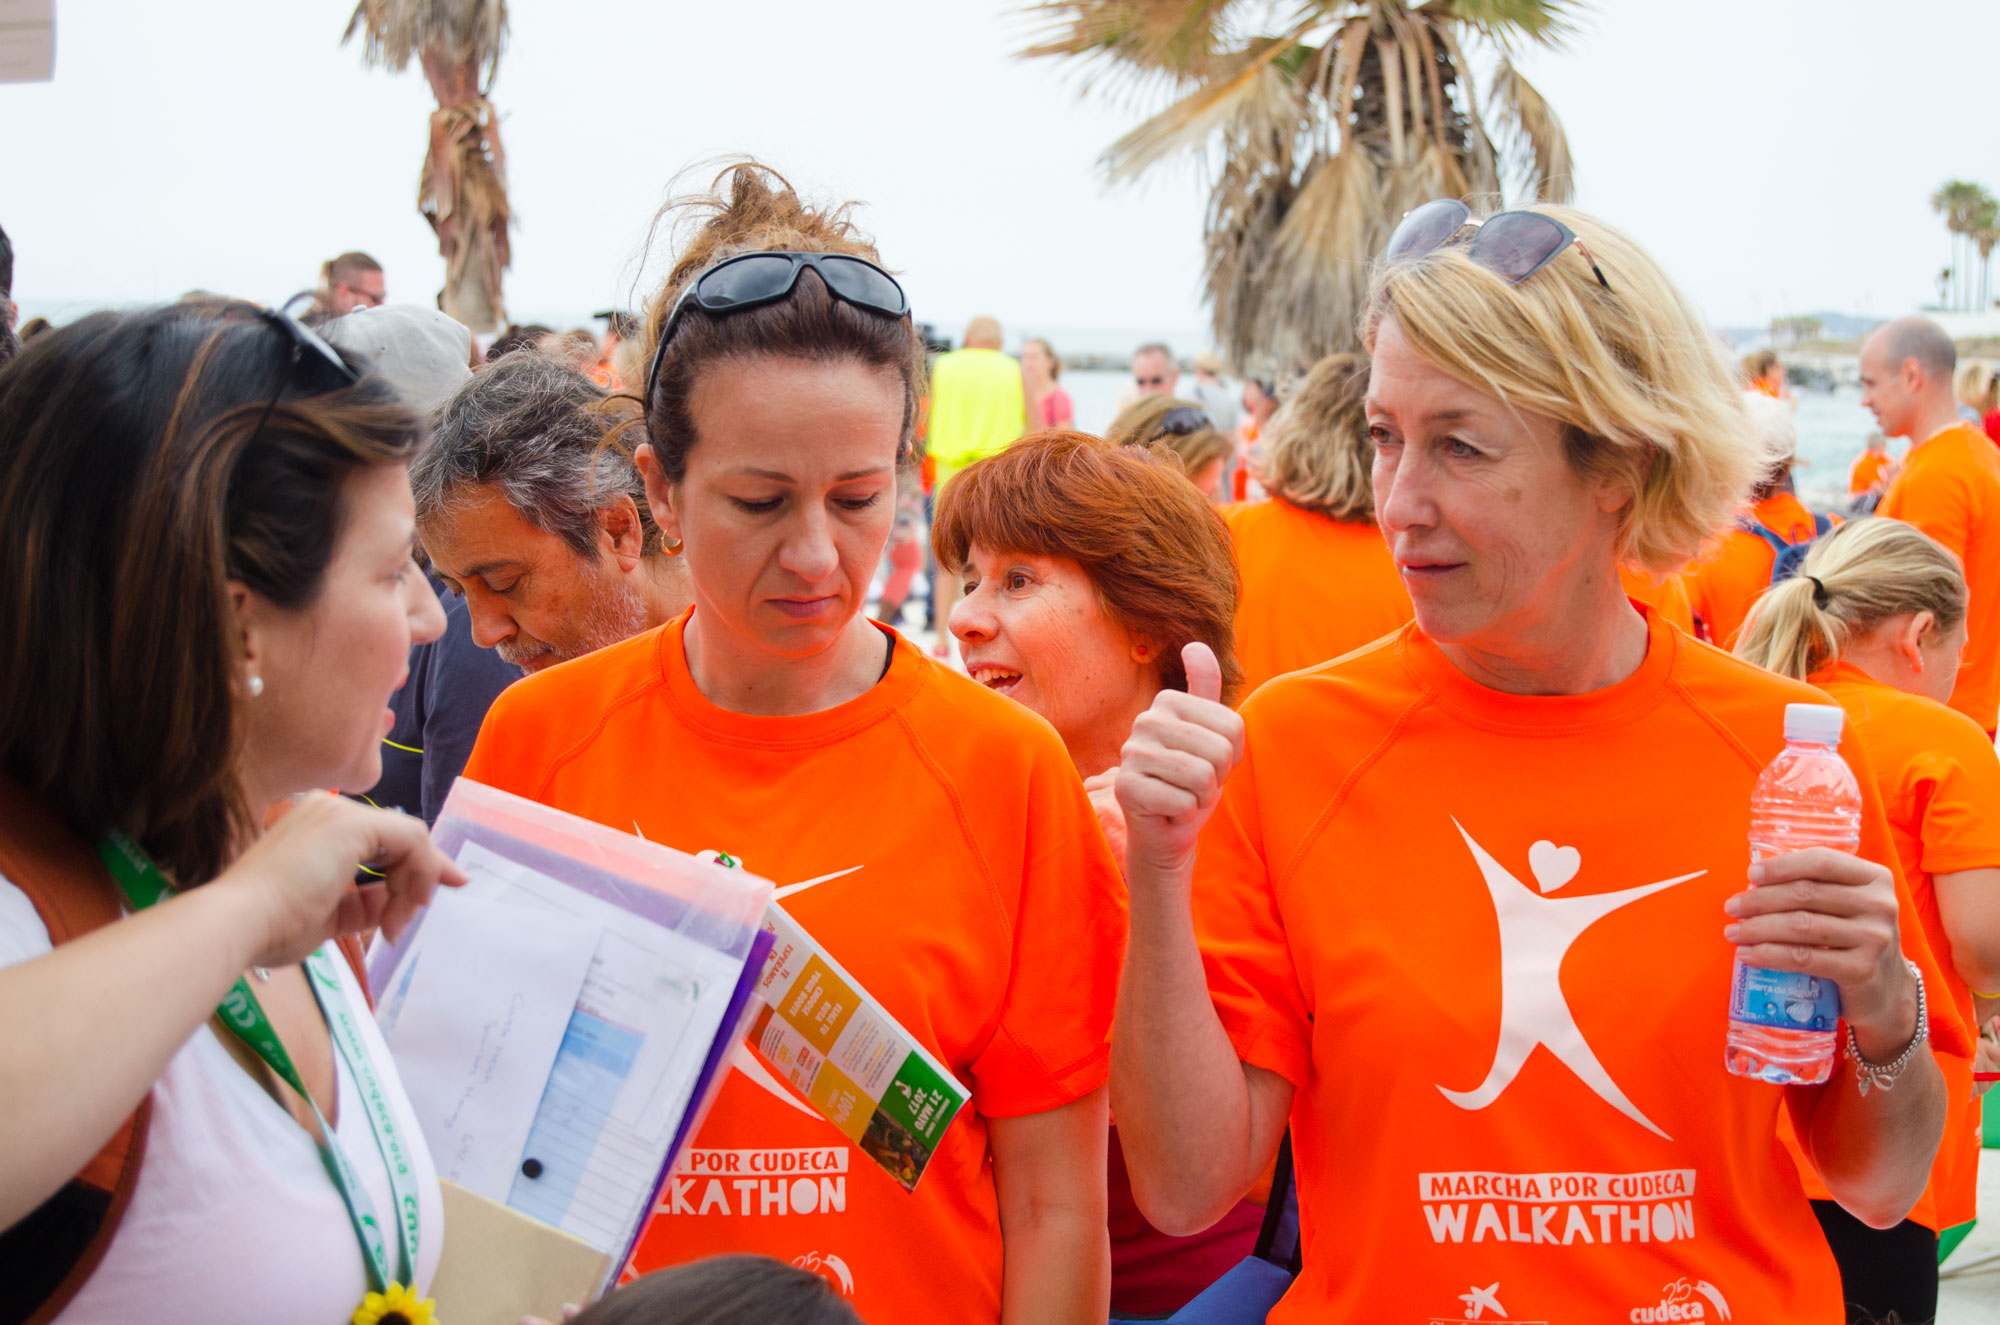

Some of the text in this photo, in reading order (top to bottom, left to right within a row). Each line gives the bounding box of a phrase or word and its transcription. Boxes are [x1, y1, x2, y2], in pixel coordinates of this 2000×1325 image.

[761, 943, 793, 988] ESPERAMOS
[779, 968, 790, 980] TE
[788, 970, 821, 1016] YOUR ROUTE
[801, 985, 823, 1016] CHOOSE
[908, 1087, 927, 1115] 2017
[913, 1089, 943, 1131] 21 MAYO
[691, 1152, 740, 1173] POR
[749, 1151, 838, 1172] CUDECA
[653, 1177, 846, 1216] KATHON
[1430, 1173, 1686, 1198] MARCHA POR CUDECA
[1423, 1199, 1696, 1245] WALKATHON
[1662, 1276, 1692, 1304] 25
[1629, 1299, 1705, 1323] cudeca
